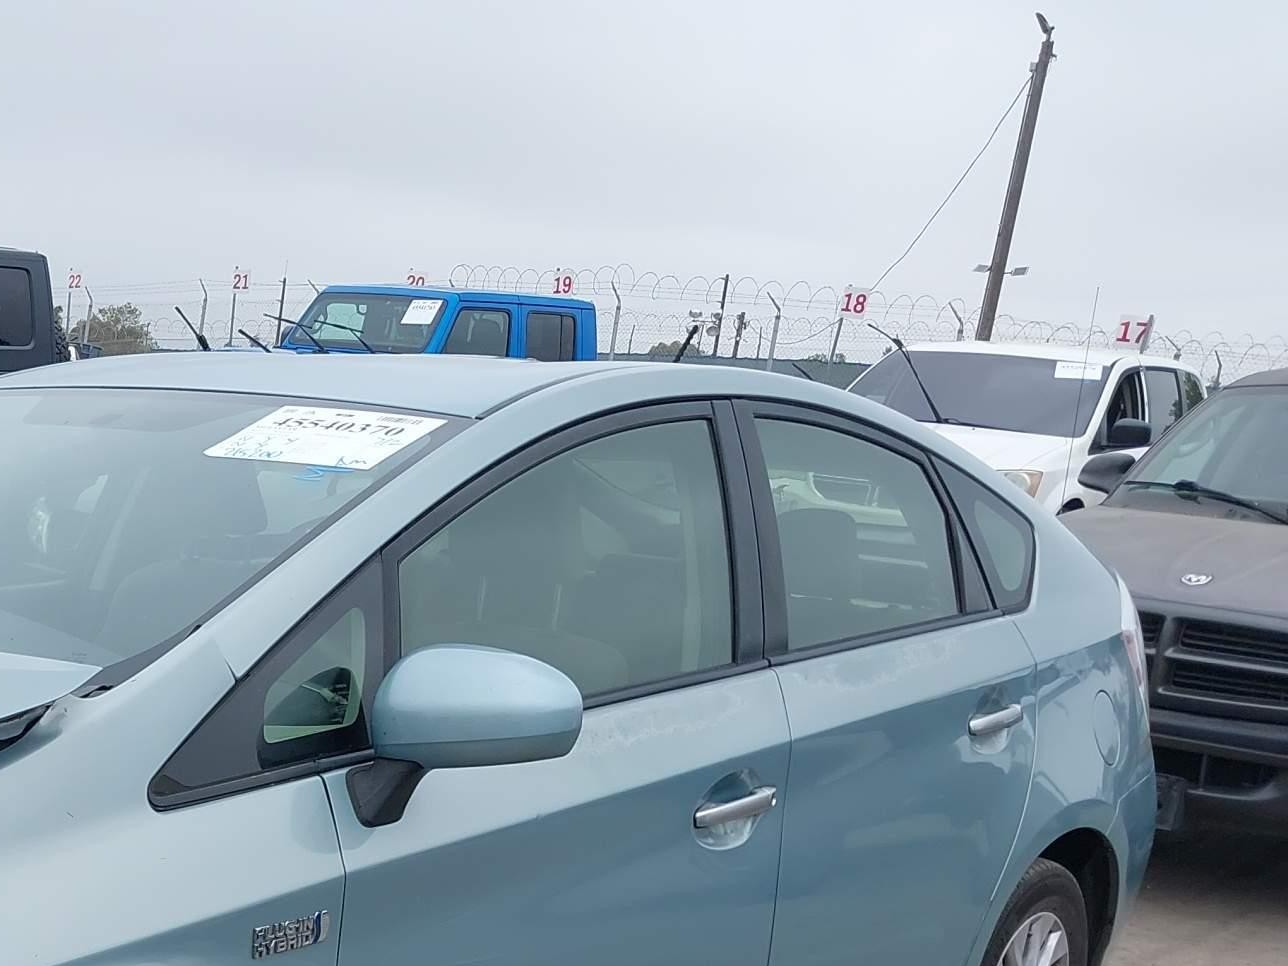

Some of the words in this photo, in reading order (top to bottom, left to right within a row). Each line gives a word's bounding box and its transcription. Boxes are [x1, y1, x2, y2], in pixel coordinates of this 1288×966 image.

[69, 275, 81, 288] 22
[233, 274, 249, 289] 21
[407, 274, 425, 286] 20
[553, 276, 572, 294] 19
[841, 292, 867, 314] 18
[1116, 320, 1153, 344] 17
[273, 417, 405, 437] 45540370
[253, 915, 315, 940] PLUG-IN
[252, 933, 313, 960] HYBRID
